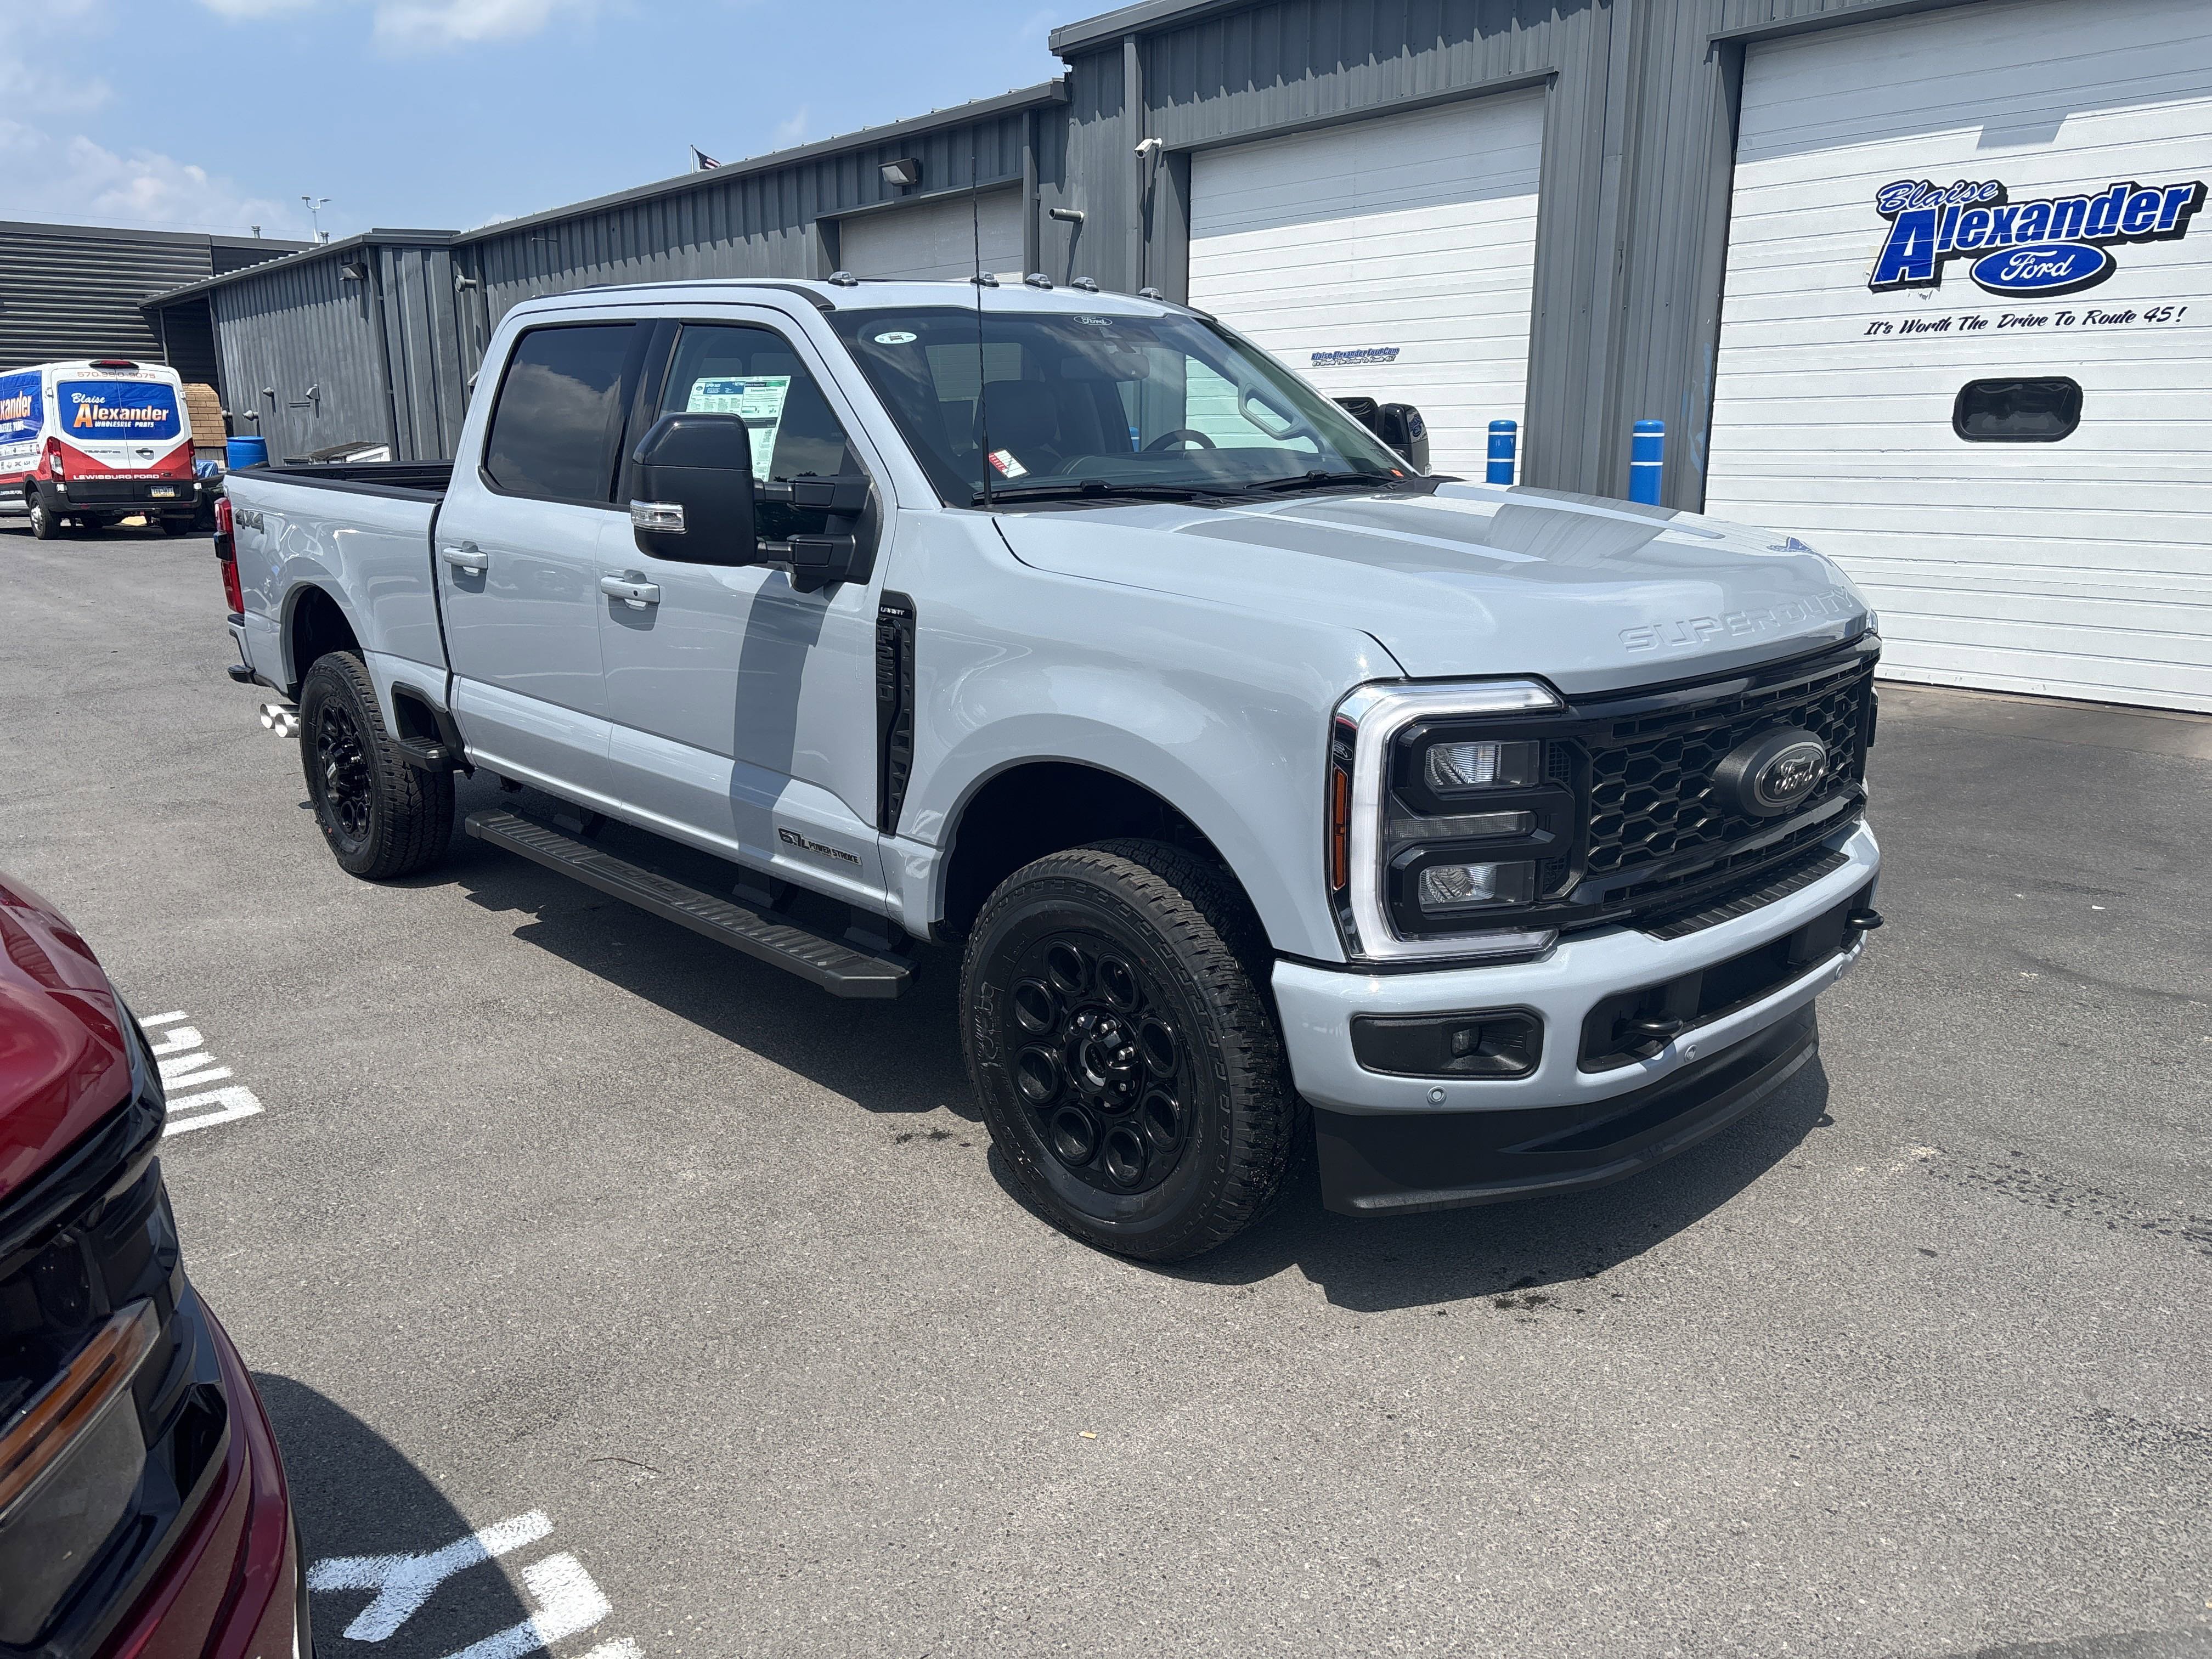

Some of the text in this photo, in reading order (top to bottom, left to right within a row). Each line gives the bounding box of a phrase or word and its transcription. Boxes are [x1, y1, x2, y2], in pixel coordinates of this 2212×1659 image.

[1878, 180, 2000, 212] Blaise
[1871, 180, 2201, 285] Alexander
[2000, 251, 2072, 280] Ford
[1864, 321, 1893, 335] It's
[1899, 316, 1950, 334] Worth
[1959, 315, 1989, 331] The
[1999, 312, 2047, 329] Drive
[2055, 311, 2075, 326] To
[2083, 309, 2137, 326] Route
[71, 392, 106, 403] Blaise
[73, 403, 170, 428] Alexander
[1774, 755, 1814, 795] Ford
[809, 841, 832, 854] POWER
[832, 849, 859, 864] STROKE
